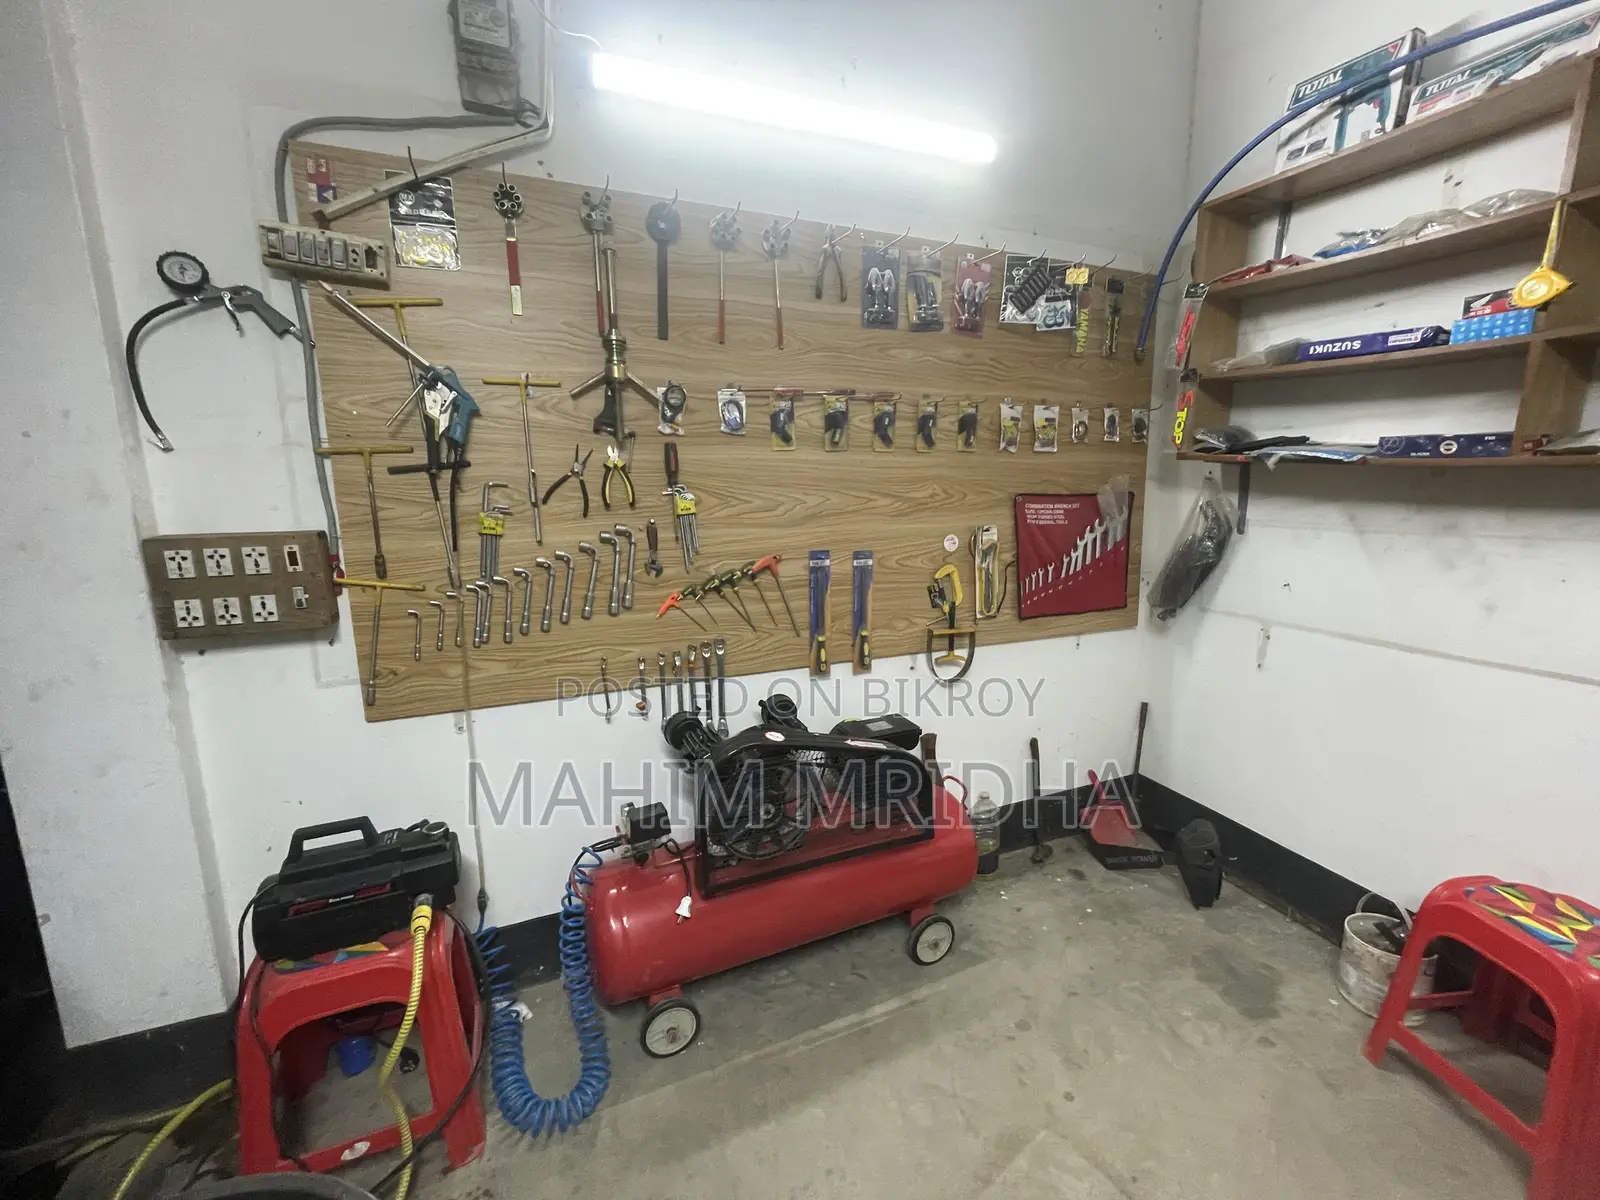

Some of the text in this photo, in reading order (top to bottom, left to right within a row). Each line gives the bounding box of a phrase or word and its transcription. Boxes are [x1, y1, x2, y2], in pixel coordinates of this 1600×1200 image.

[1298, 69, 1343, 98] TOTAL
[1425, 70, 1471, 97] TOTAL
[1308, 340, 1362, 355] SUZUKI
